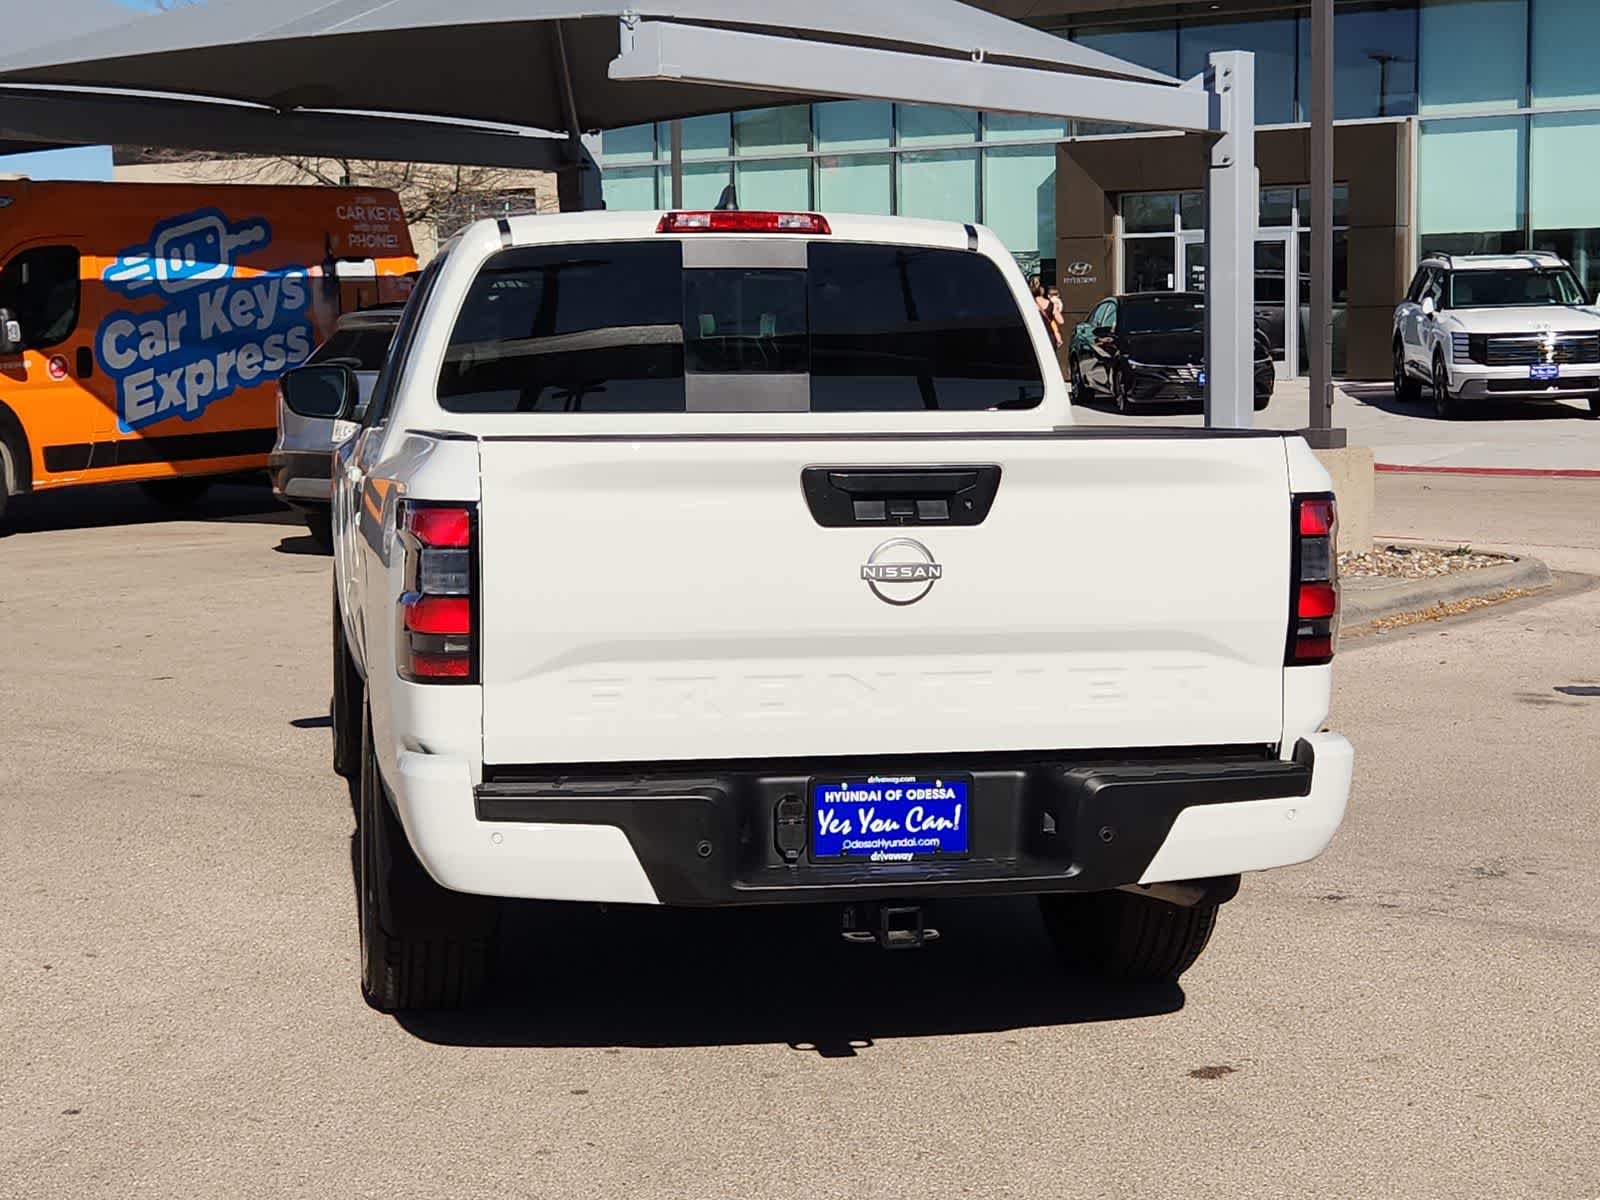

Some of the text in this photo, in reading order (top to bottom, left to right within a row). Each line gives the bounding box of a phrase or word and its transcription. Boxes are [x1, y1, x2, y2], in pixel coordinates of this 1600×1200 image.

[336, 206, 400, 221] CAR KEYS
[102, 271, 305, 369] Car Keys
[122, 325, 309, 424] Express
[863, 566, 941, 578] NISSAN
[825, 788, 956, 803] HYUNDAI OF ODESSA
[818, 804, 962, 835] Yes You Can!
[842, 837, 940, 850] OdessaHyundai.com
